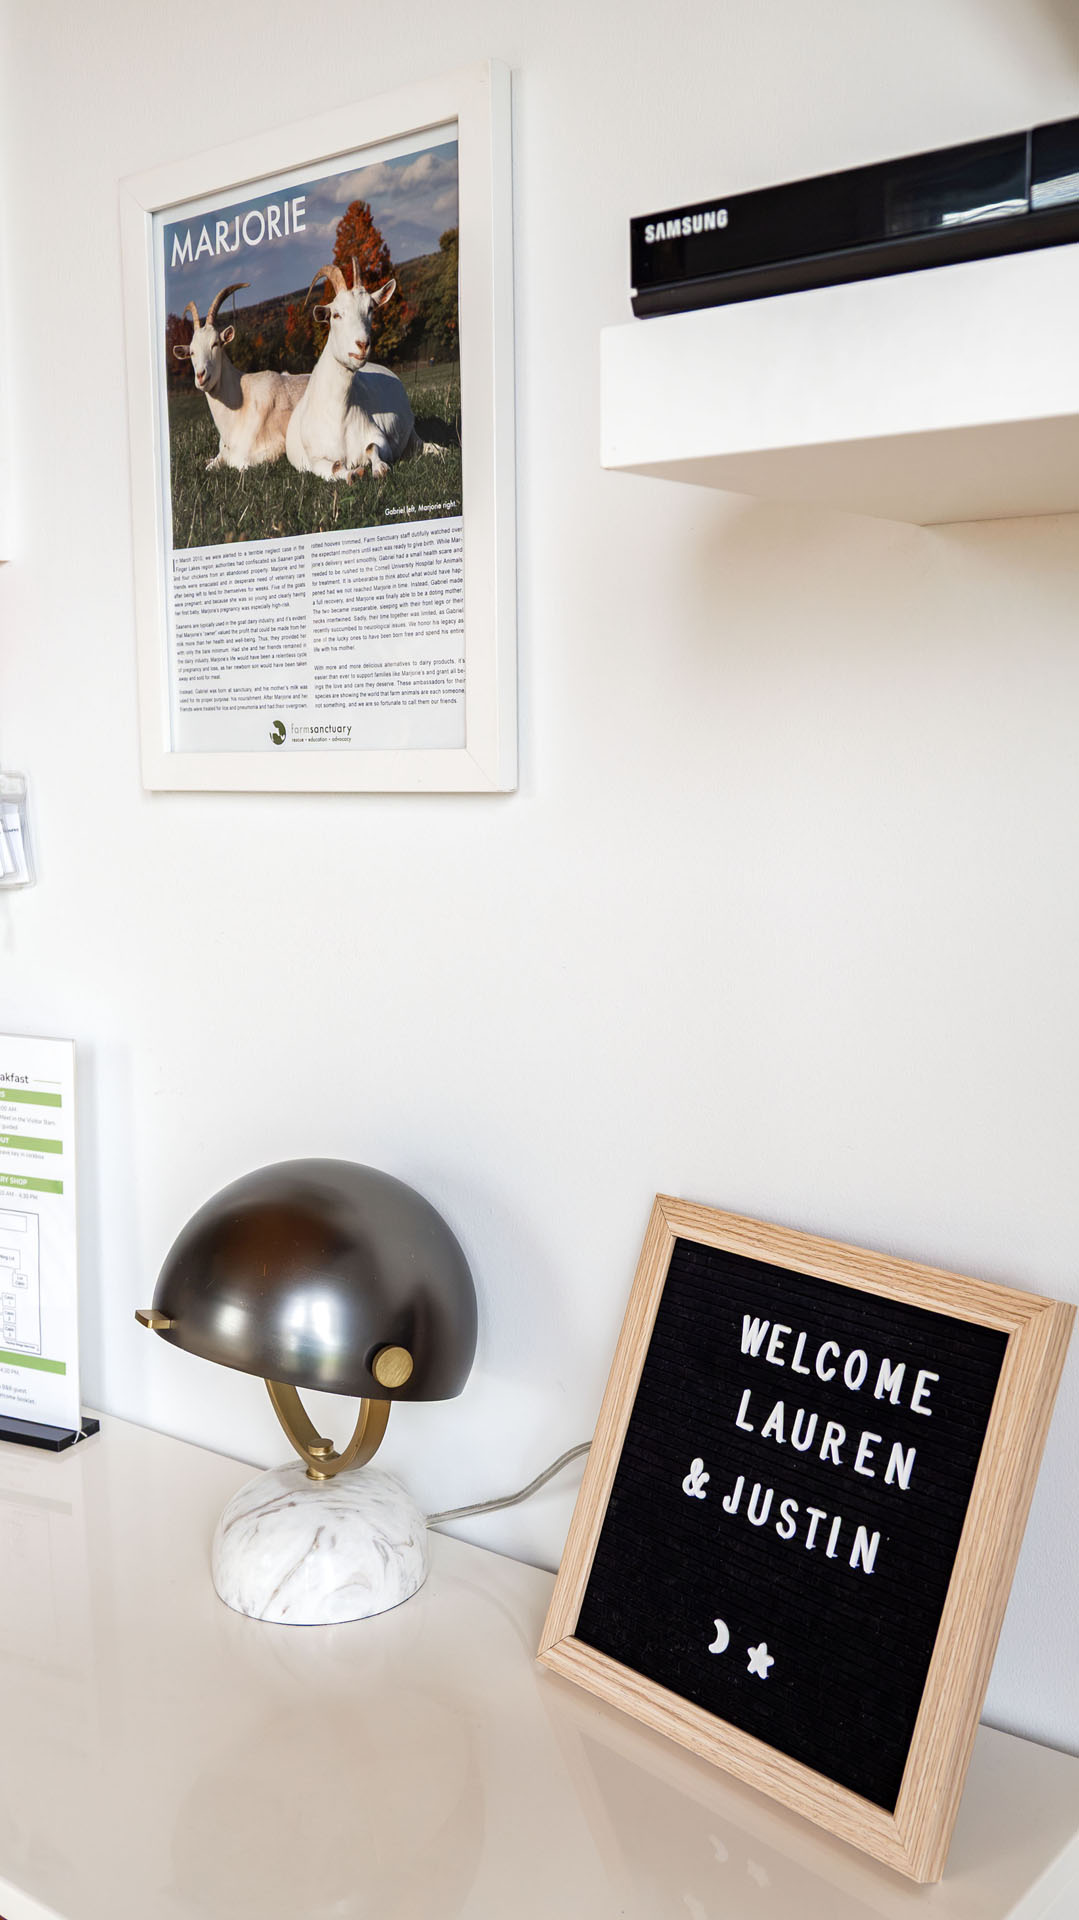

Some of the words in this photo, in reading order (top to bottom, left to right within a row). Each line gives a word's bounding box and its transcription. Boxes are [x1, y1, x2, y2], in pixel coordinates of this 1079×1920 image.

[171, 196, 306, 267] MARJORIE
[645, 209, 728, 243] SAMSUNG
[385, 506, 405, 515] Gabriel
[418, 502, 441, 512] Marjorie
[291, 723, 352, 735] farmsanctuary
[10, 1176, 28, 1186] SHOP
[741, 1314, 940, 1416] WELCOME
[735, 1388, 917, 1491] LAUREN
[682, 1457, 711, 1500] &
[722, 1475, 881, 1575] JUSTIN
